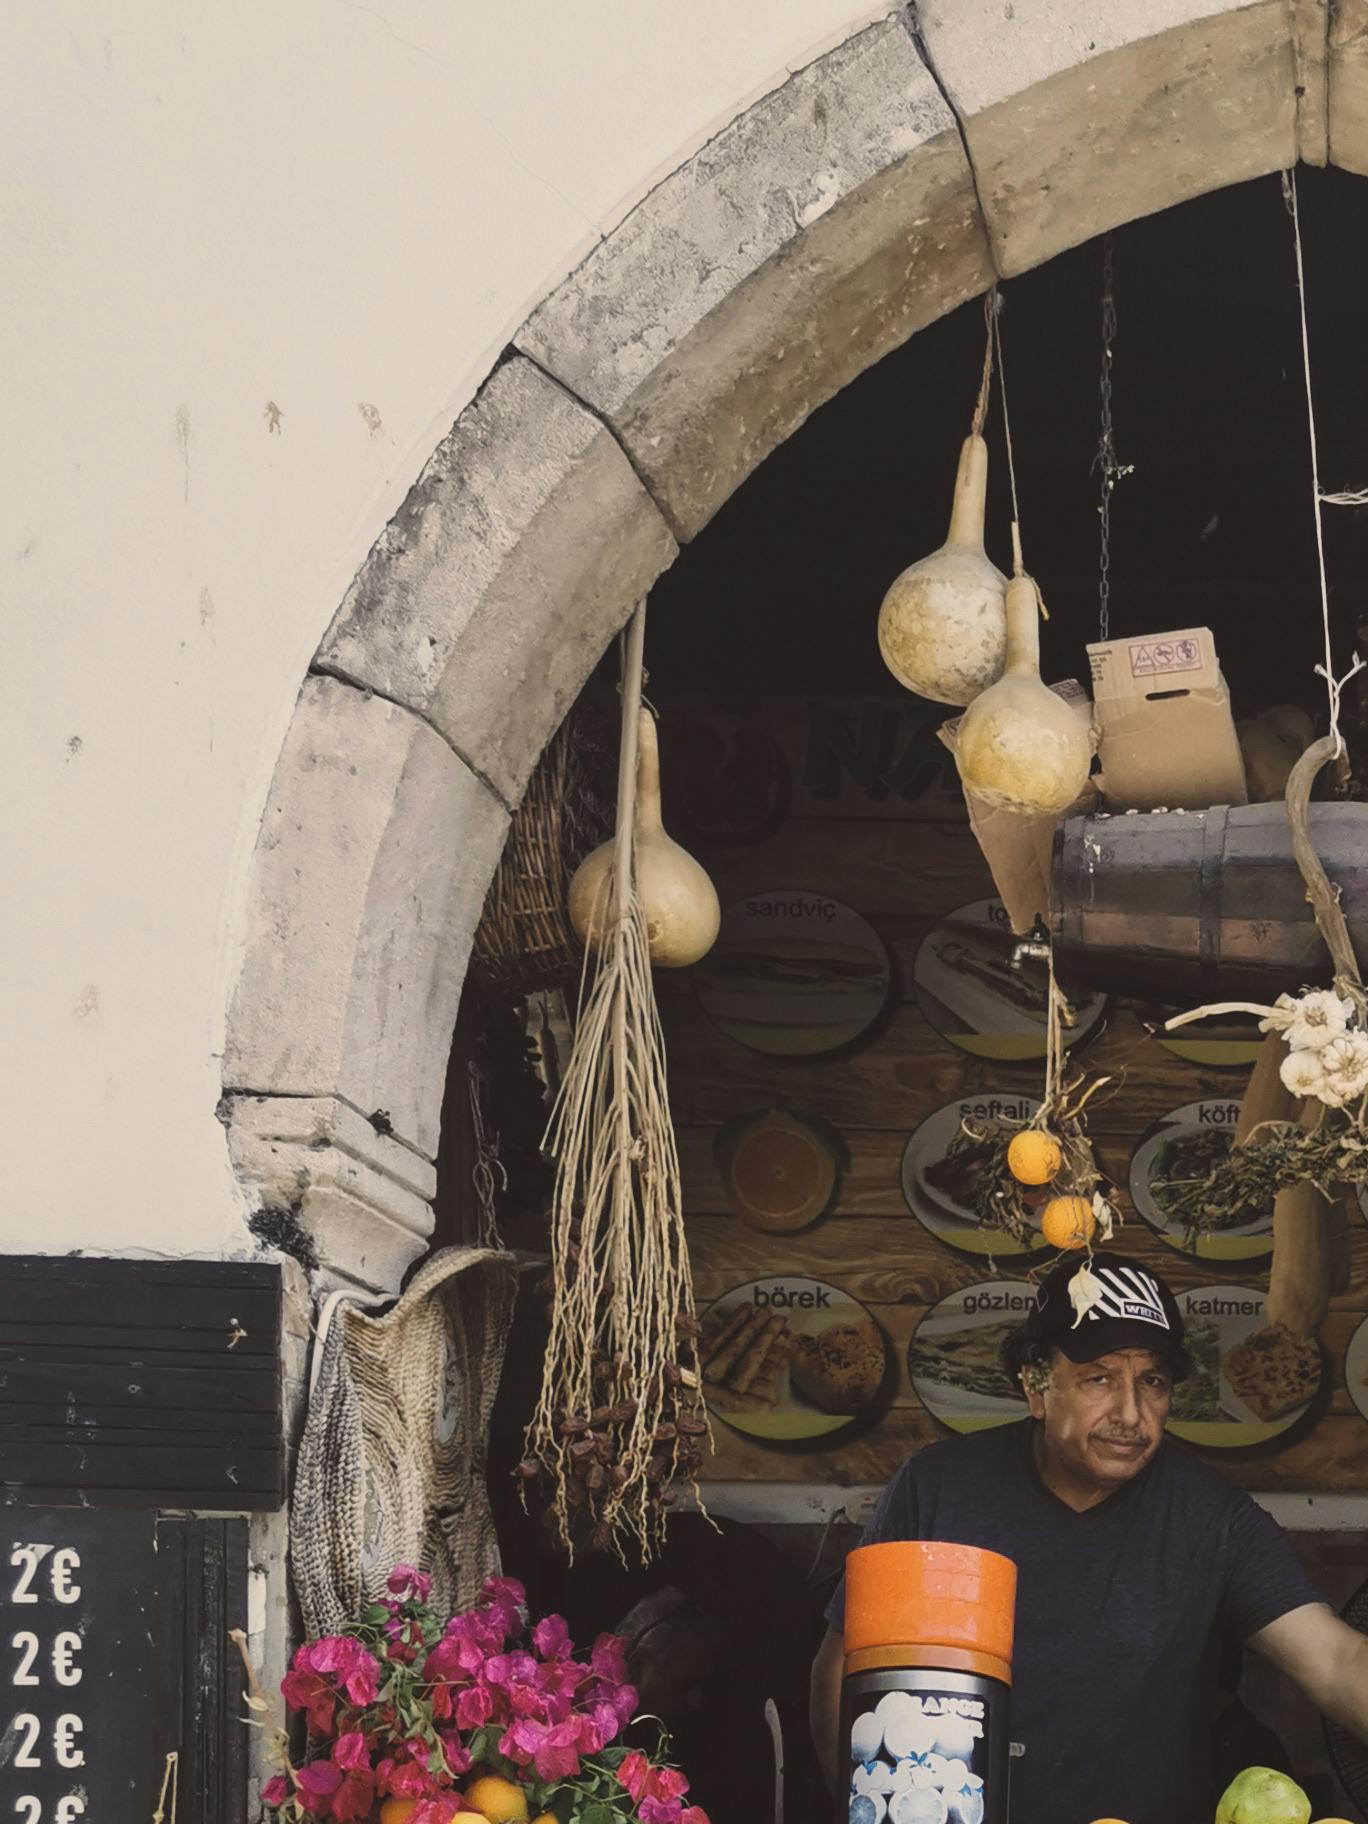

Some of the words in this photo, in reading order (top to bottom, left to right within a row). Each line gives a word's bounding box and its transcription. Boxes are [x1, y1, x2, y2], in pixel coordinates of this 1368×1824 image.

[745, 898, 836, 923] sandviç
[988, 903, 1008, 922] to
[1198, 1104, 1241, 1124] köft
[753, 1286, 831, 1309] börek
[1186, 1296, 1265, 1316] katmer
